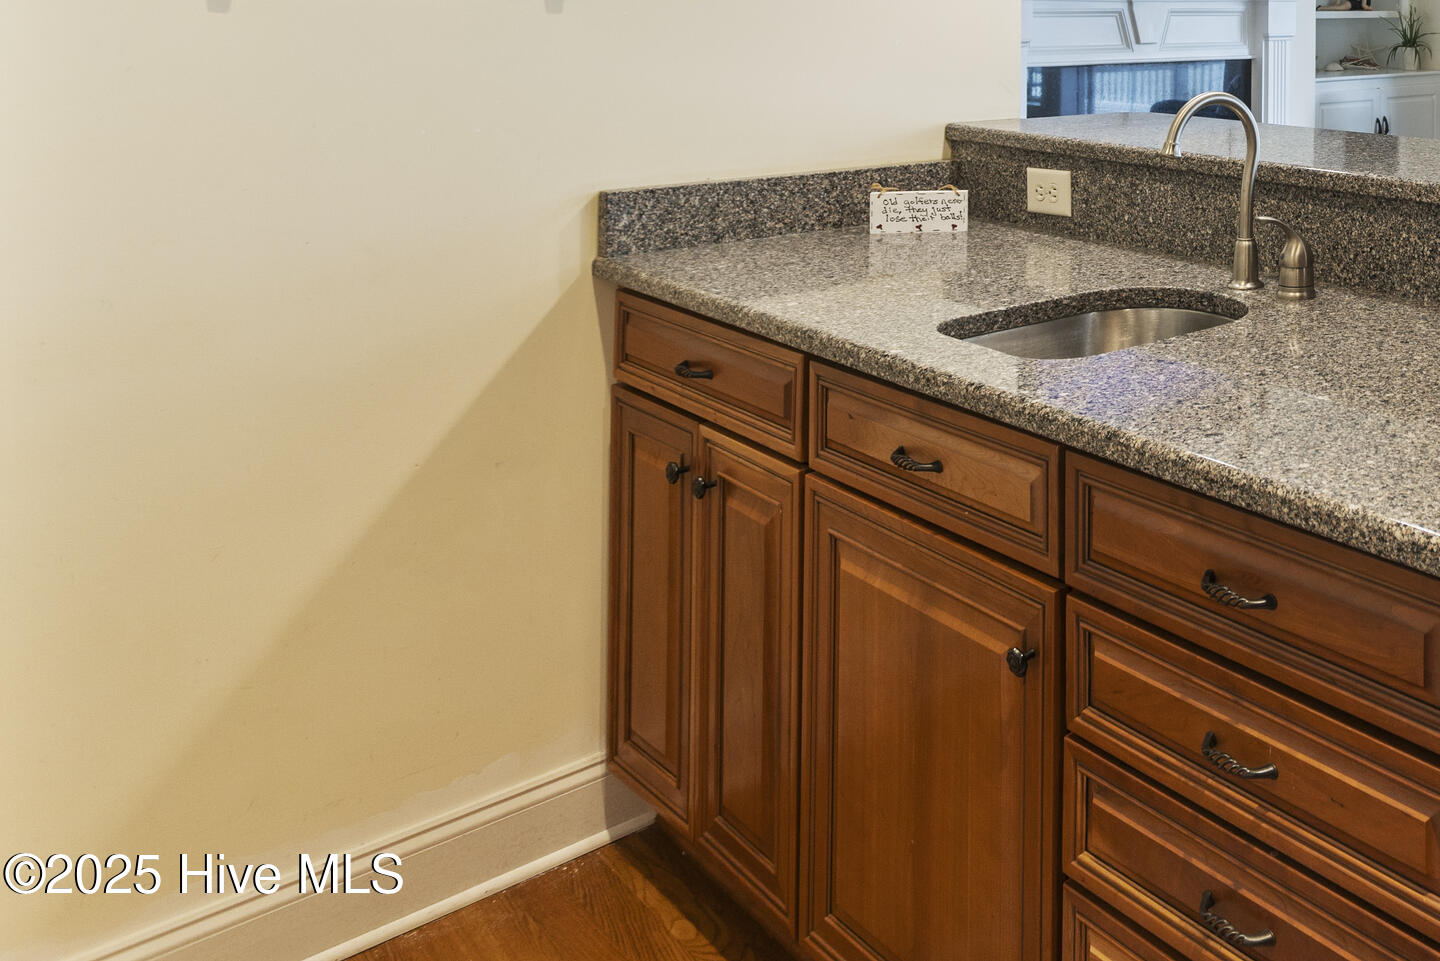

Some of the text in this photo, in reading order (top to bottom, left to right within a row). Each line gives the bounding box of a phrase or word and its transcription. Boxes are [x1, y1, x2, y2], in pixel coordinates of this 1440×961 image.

[883, 197, 898, 206] Old
[903, 196, 938, 209] golfers
[885, 210, 963, 223] lose their balls!
[905, 205, 929, 217] they
[931, 204, 952, 217] just
